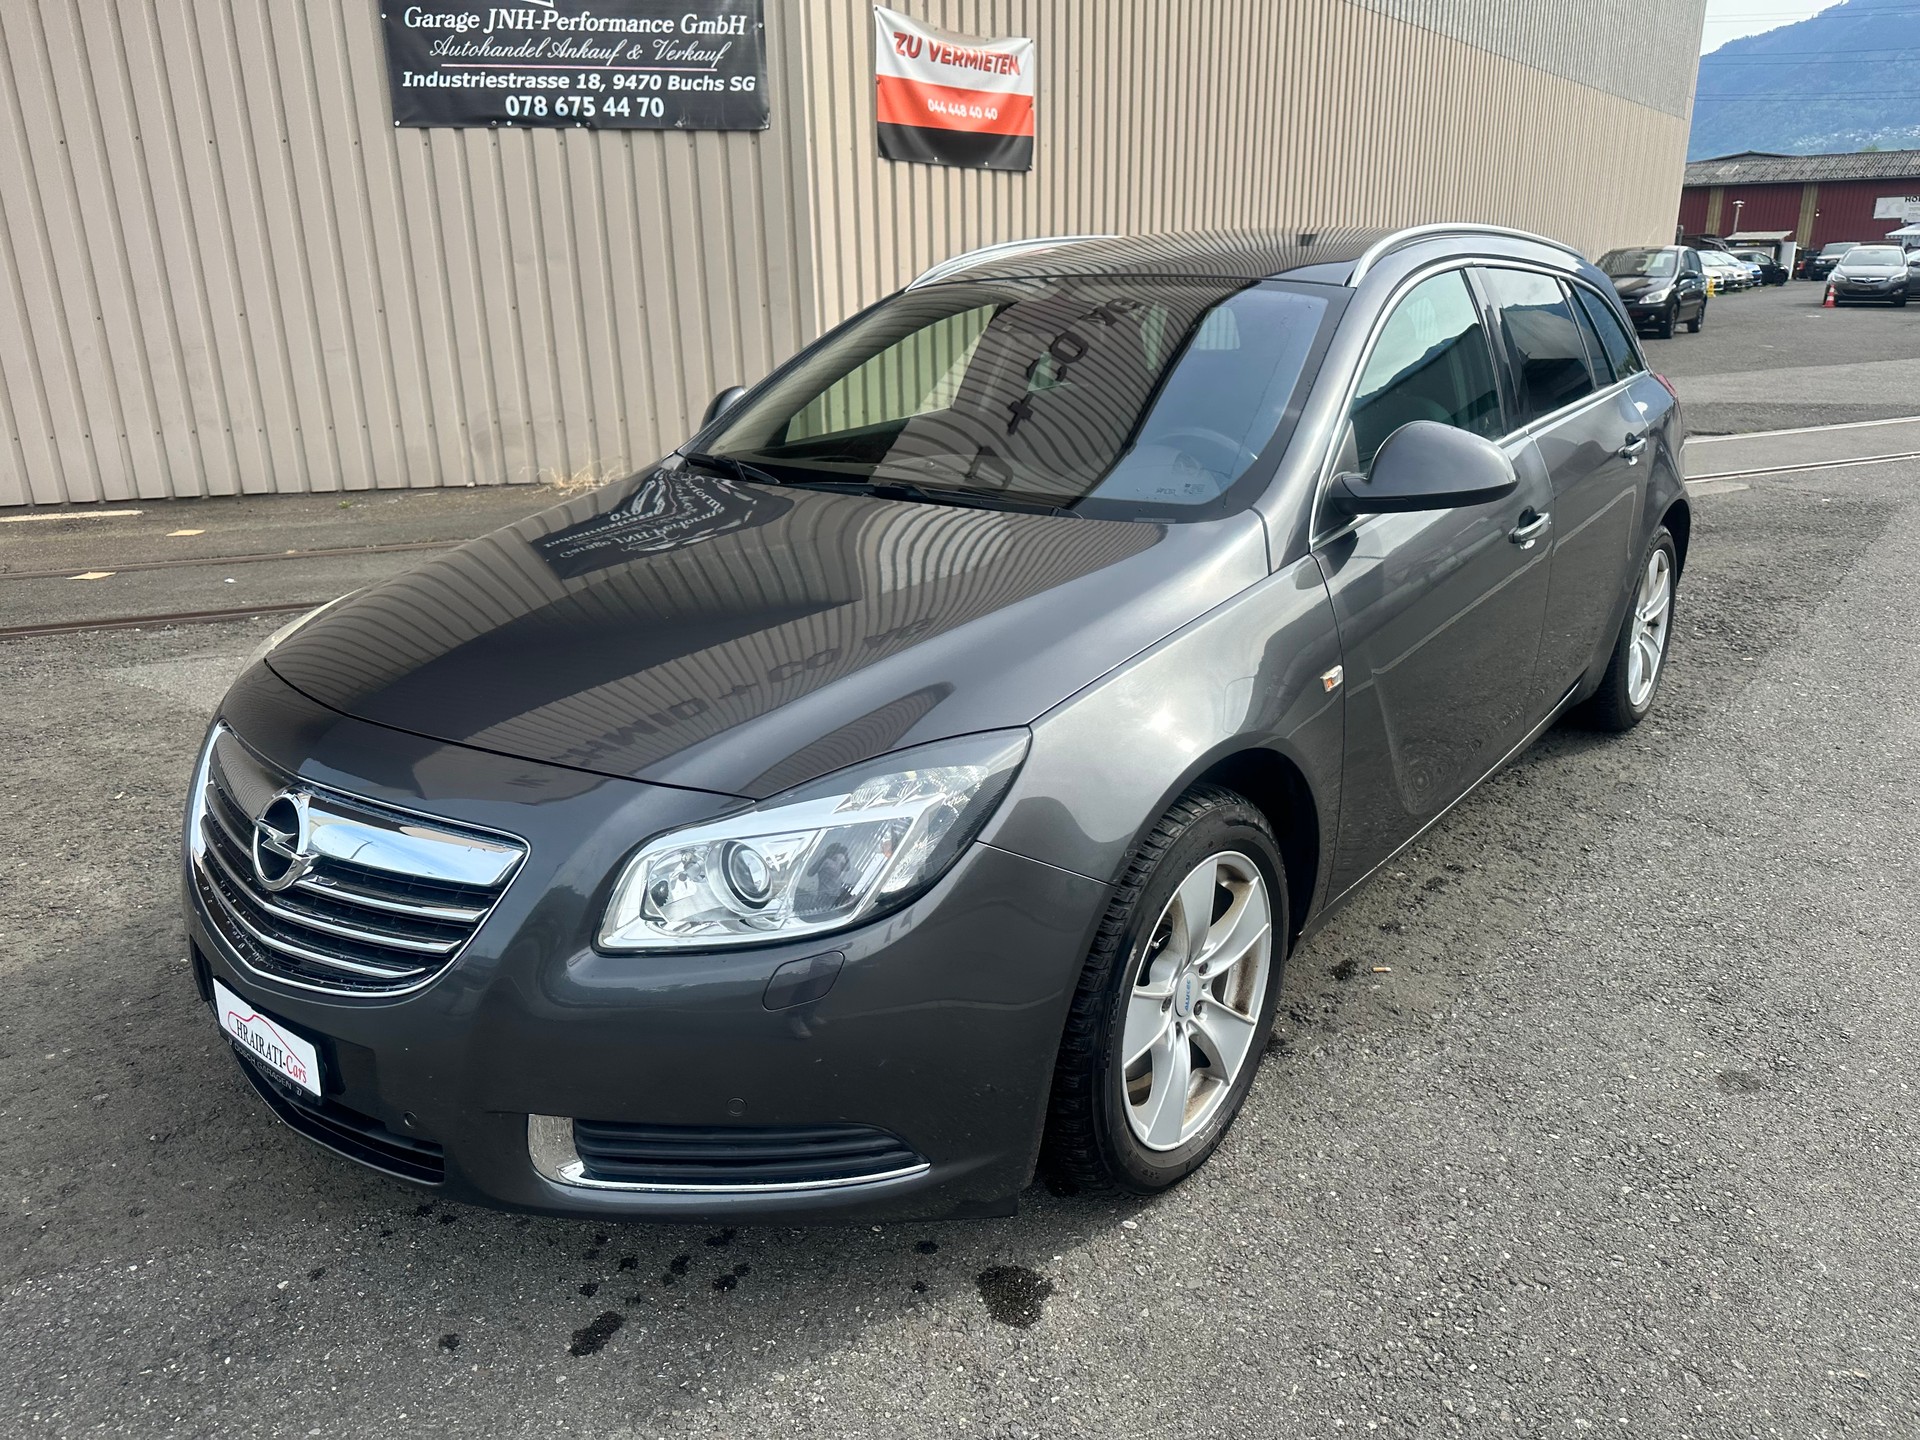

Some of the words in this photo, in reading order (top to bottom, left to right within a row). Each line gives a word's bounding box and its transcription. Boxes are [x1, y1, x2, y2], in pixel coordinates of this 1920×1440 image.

[404, 6, 480, 33] Garage
[483, 8, 674, 34] JNH-Performance
[680, 13, 747, 35] GmbH
[429, 35, 551, 58] Autohandel
[547, 37, 628, 66] Ankauf
[626, 44, 643, 60] &
[653, 39, 732, 68] Verkauf
[893, 31, 922, 59] ZU
[927, 40, 1021, 76] VERMIETEN
[402, 71, 570, 89] Industriestrasse
[576, 73, 606, 92] 18,
[612, 74, 662, 90] 9470
[667, 75, 725, 91] Buchs
[729, 76, 756, 92] SG
[505, 95, 548, 116] 078
[554, 96, 596, 117] 675
[602, 97, 630, 117] 44
[636, 97, 665, 117] 70
[927, 98, 947, 115] 044
[948, 102, 967, 118] 448
[969, 106, 983, 119] 40
[984, 106, 998, 120] 40
